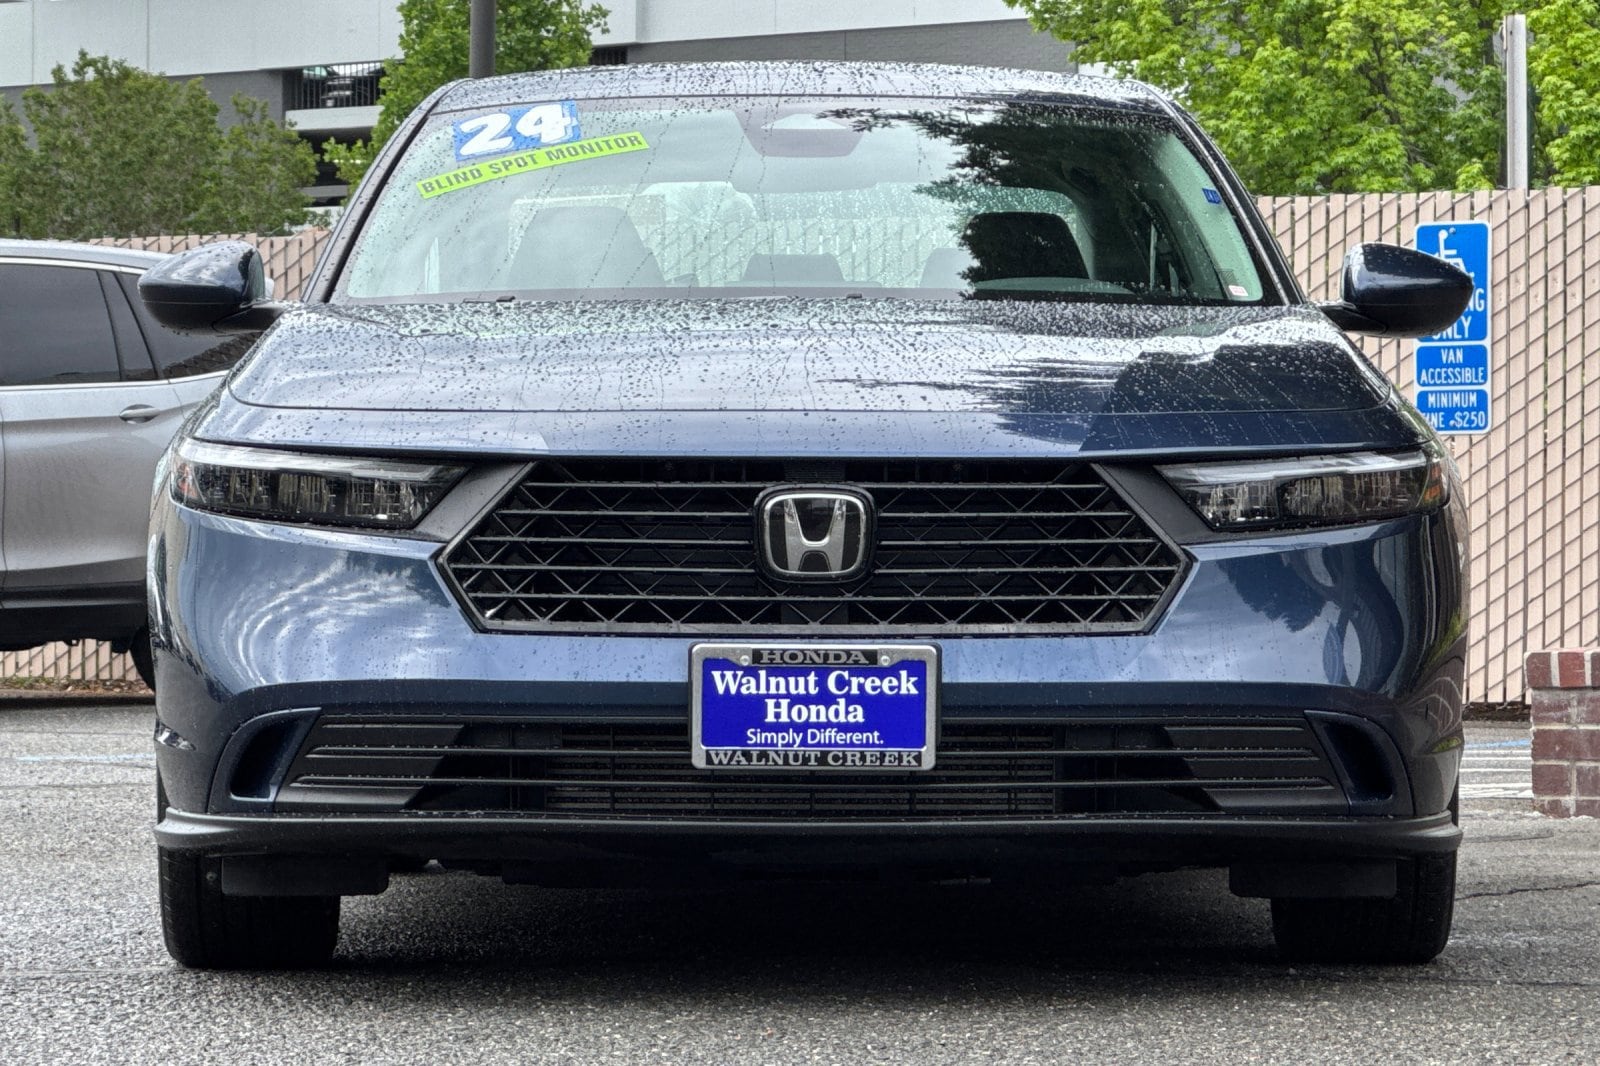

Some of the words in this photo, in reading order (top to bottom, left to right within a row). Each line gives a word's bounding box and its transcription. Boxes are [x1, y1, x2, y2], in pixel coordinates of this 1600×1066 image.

[459, 103, 571, 156] 24
[421, 167, 483, 194] BLIND
[488, 153, 539, 175] SPOT
[549, 134, 644, 162] MONITOR
[1432, 315, 1472, 340] NLY
[1441, 348, 1464, 364] VAN
[1420, 367, 1485, 385] ACCESSIBLE
[1428, 391, 1477, 409] MINIMUM
[1423, 412, 1445, 428] INE
[1454, 410, 1486, 429] $250
[760, 650, 869, 664] HONDA
[711, 670, 819, 695] Walnut
[827, 670, 919, 695] Creek
[764, 698, 865, 723] Honda
[746, 728, 803, 748] Simply
[807, 729, 884, 745] Different.
[708, 751, 821, 766] WALNUT
[827, 751, 919, 767] CREEK
